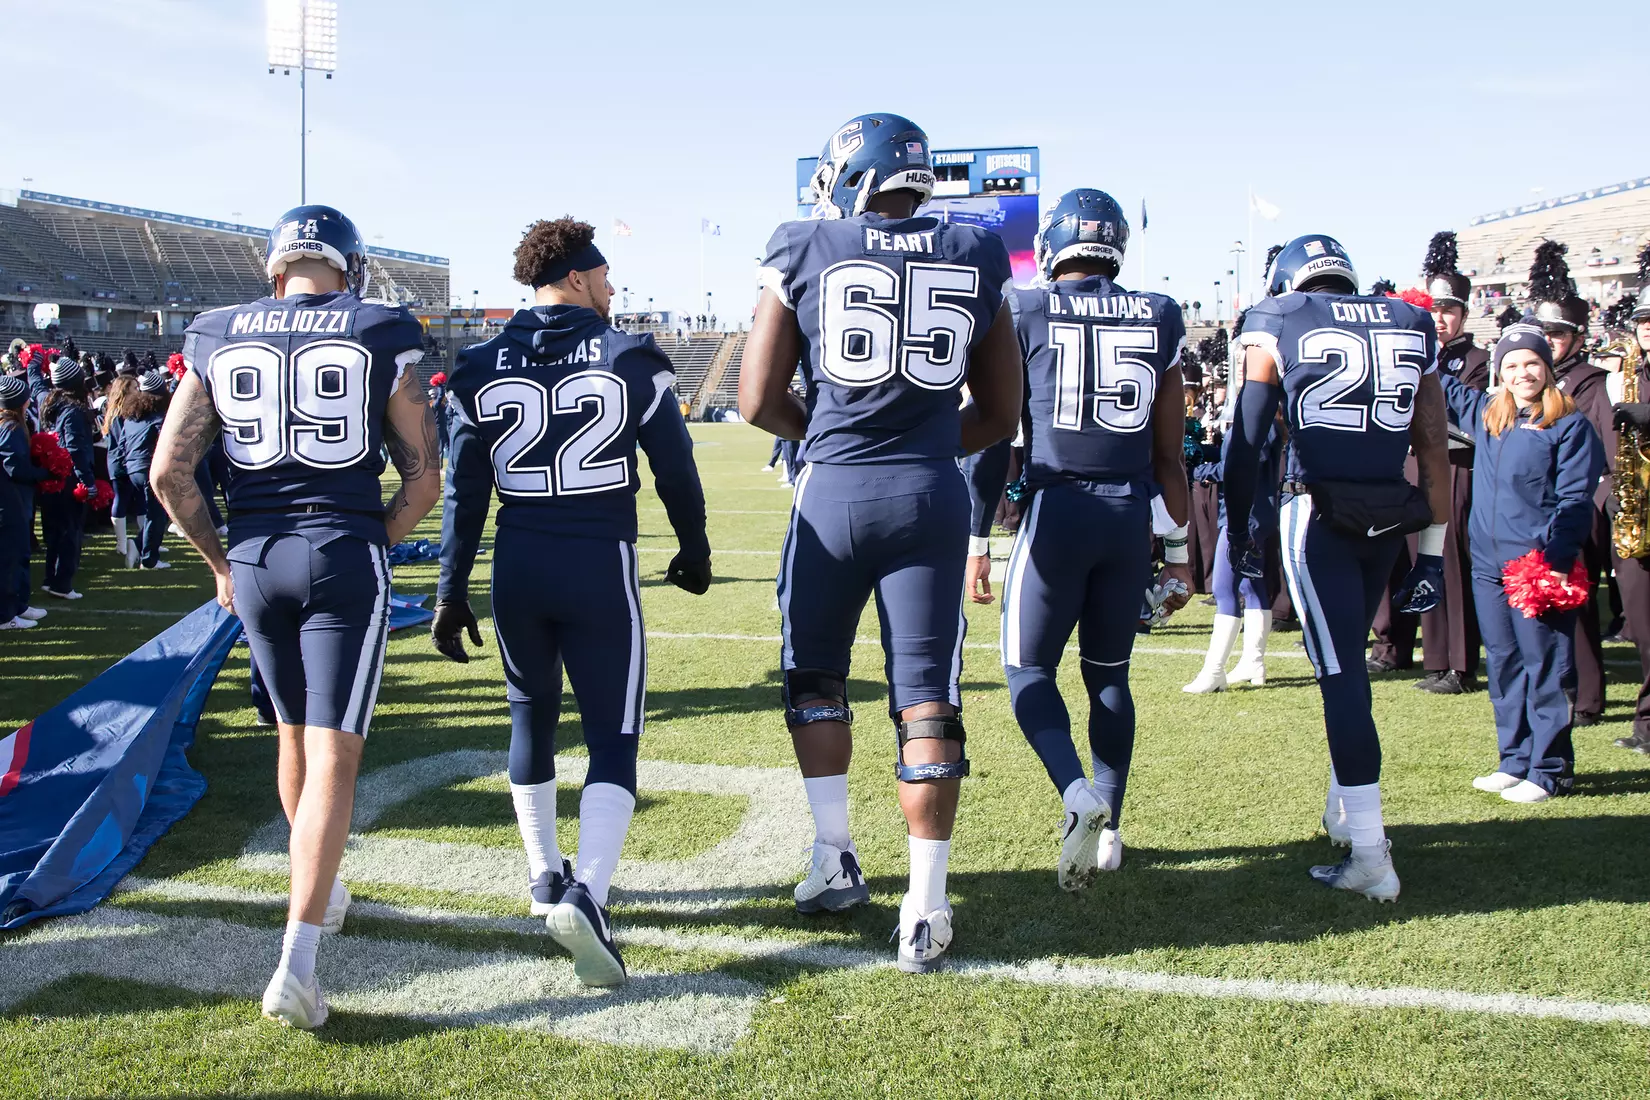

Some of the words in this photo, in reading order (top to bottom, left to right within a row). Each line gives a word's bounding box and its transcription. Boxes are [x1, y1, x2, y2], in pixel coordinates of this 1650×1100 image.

[935, 152, 975, 165] STADIUM
[277, 241, 323, 255] HUSKIES
[866, 228, 934, 253] PEART
[1081, 245, 1114, 255] HUSKIES
[1049, 293, 1067, 314] D.
[1069, 295, 1153, 319] WILLIAMS
[1331, 302, 1391, 323] COYLE
[231, 310, 351, 335] MAGLIOZZI
[819, 259, 979, 390] 65
[495, 347, 512, 371] E.
[1048, 322, 1158, 433] 15
[1297, 327, 1426, 432] 25
[208, 339, 373, 470] 99
[474, 370, 629, 497] 22
